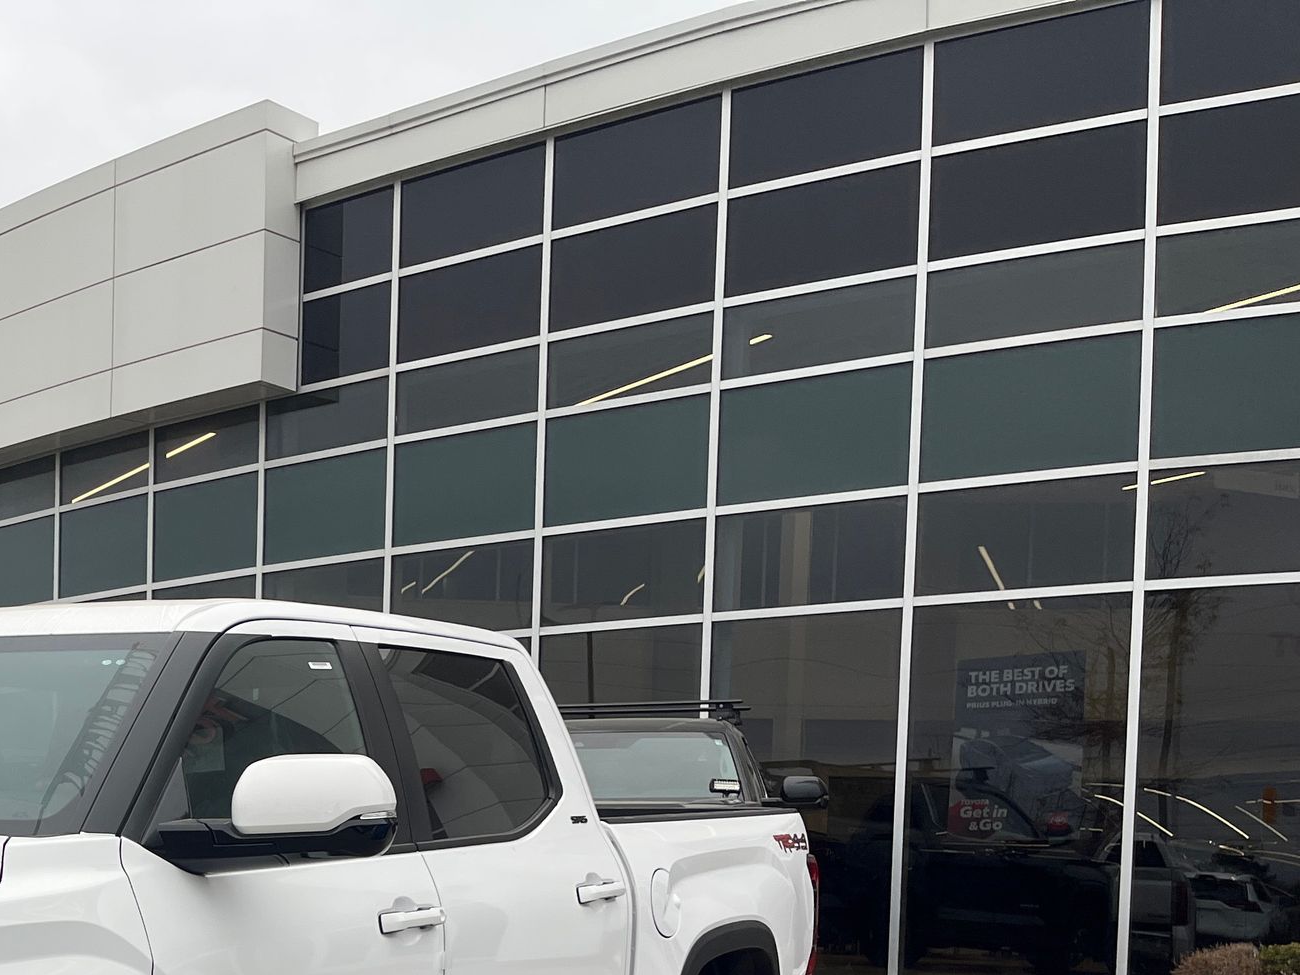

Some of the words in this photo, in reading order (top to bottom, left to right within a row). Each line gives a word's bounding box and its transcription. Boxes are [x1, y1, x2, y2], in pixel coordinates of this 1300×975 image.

[969, 670, 1000, 684] THE
[1003, 667, 1042, 682] BEST
[1045, 665, 1069, 678] OF
[967, 682, 1011, 698] BOTH
[1015, 679, 1075, 694] DRIVES
[966, 701, 990, 709] PRIUS
[1026, 698, 1058, 706] HYBRID
[960, 806, 988, 818] Get
[992, 805, 1008, 818] in
